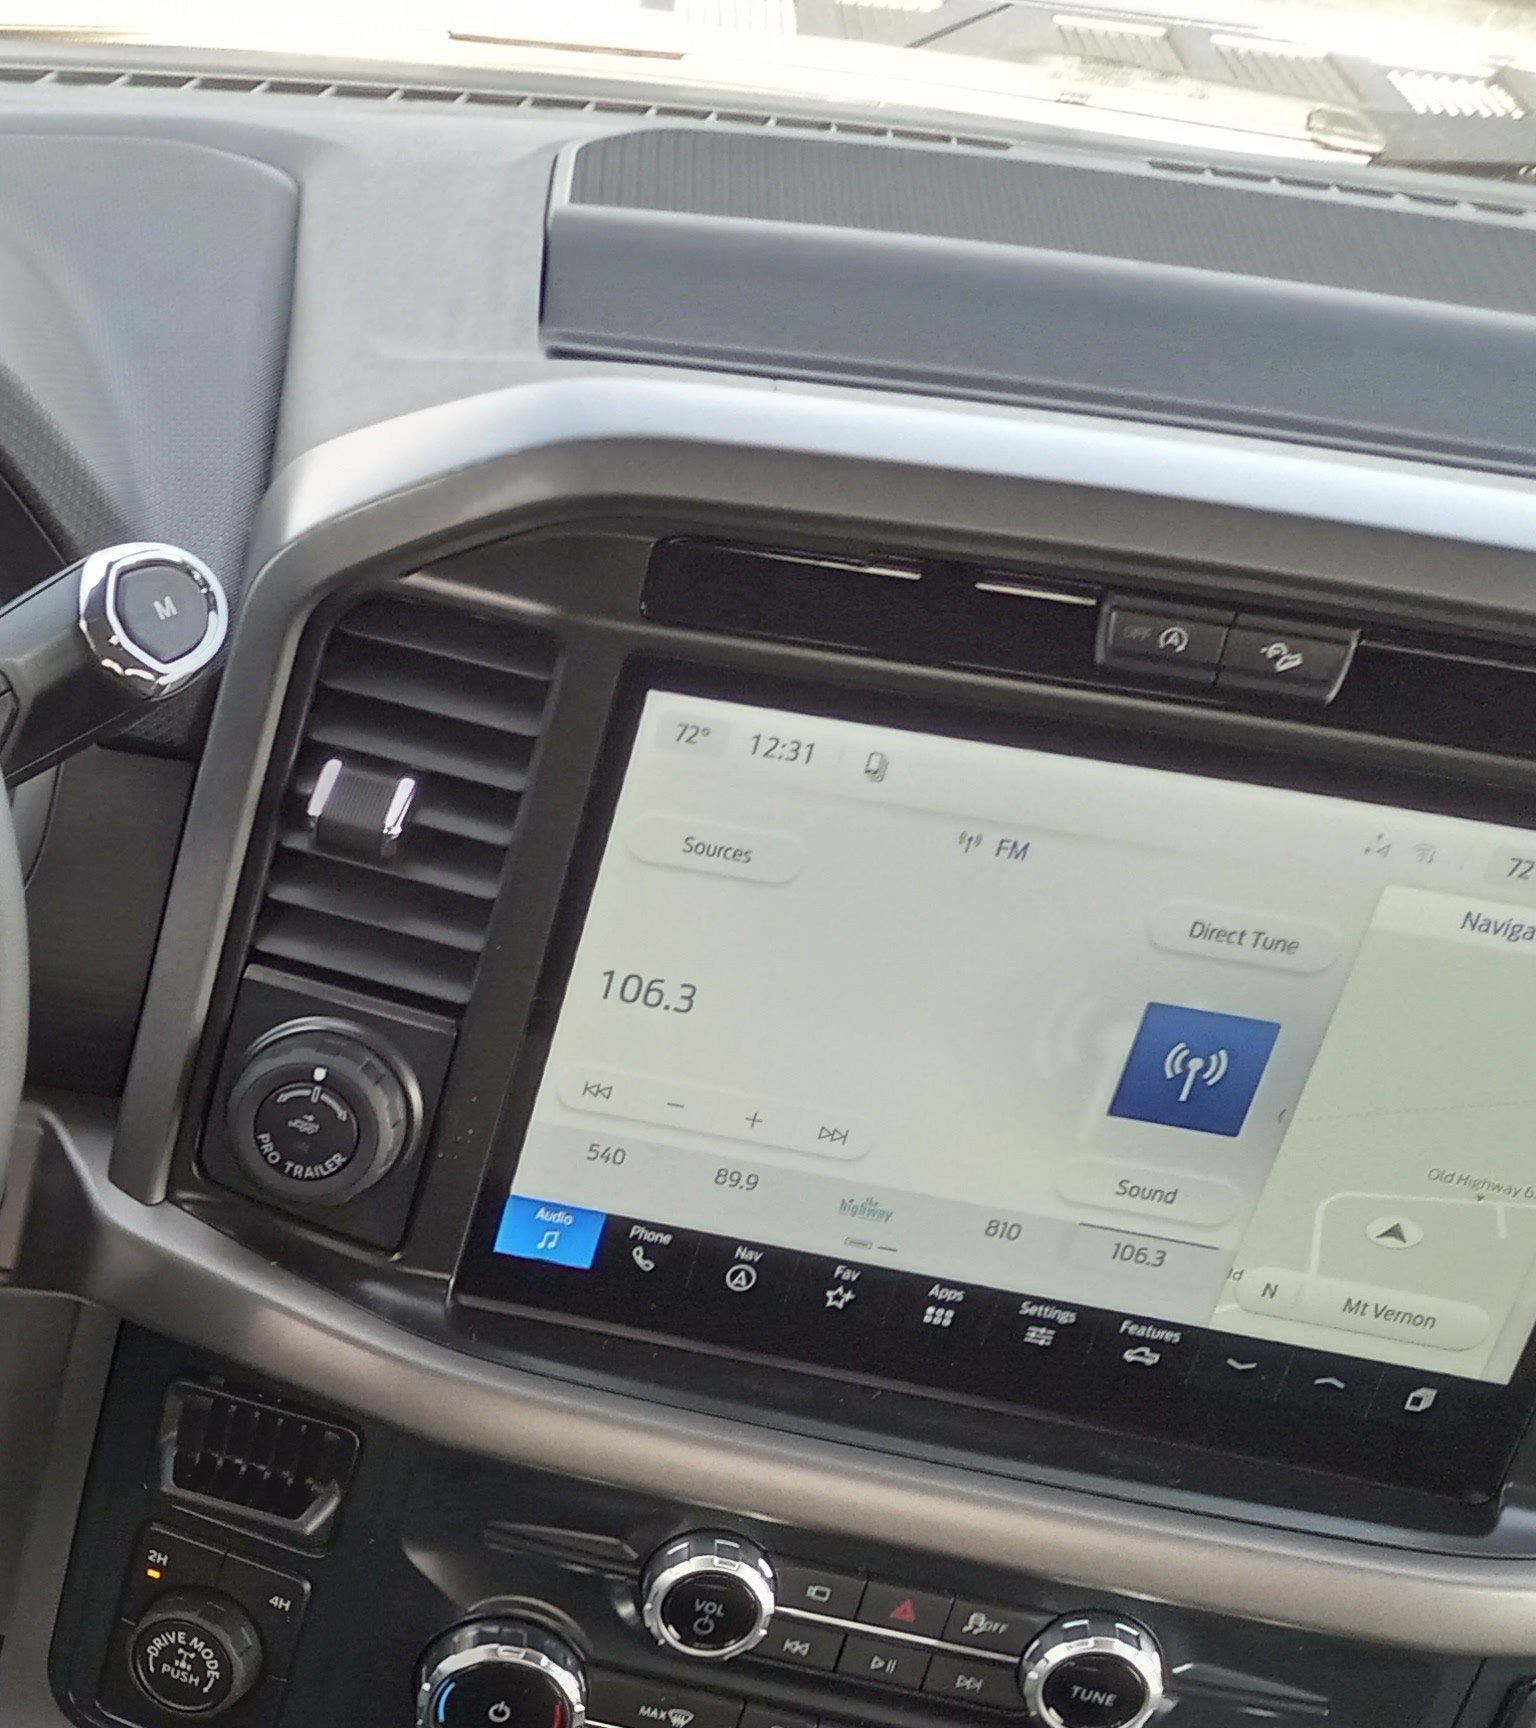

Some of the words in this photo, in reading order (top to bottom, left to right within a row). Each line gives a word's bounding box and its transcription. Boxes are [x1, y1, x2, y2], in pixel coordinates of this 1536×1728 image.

[153, 596, 177, 620] M
[748, 734, 816, 765] 12:31
[681, 836, 753, 865] Sources
[995, 838, 1030, 861] FM
[1188, 920, 1247, 947] Direct
[1251, 930, 1301, 955] Tune
[601, 969, 698, 1014] 106.3
[257, 1132, 281, 1164] PRO
[284, 1152, 348, 1179] TRAILER
[586, 1143, 626, 1166] 540
[713, 1167, 759, 1191] 89.9
[1427, 1168, 1455, 1185] Old
[1456, 1175, 1521, 1199] Highway
[1115, 1179, 1178, 1205] Sound
[535, 1206, 573, 1226] Audio
[629, 1225, 673, 1245] Phone
[984, 1218, 1022, 1241] 810
[734, 1245, 763, 1263] Nav
[1111, 1241, 1167, 1268] 106.3
[833, 1265, 861, 1283] Fav
[927, 1284, 965, 1303] Apps
[1261, 1283, 1278, 1299] N
[1019, 1301, 1077, 1326] Settings
[1342, 1298, 1369, 1318] Mt
[1373, 1304, 1436, 1330] Vernon
[1120, 1320, 1181, 1344] Features
[147, 1549, 168, 1566] 2H
[268, 1595, 291, 1612] 4H
[694, 1598, 725, 1617] VOL
[983, 1620, 1009, 1636] OFF
[146, 1631, 186, 1658] DRIVE
[189, 1637, 220, 1680] MODE
[161, 1662, 200, 1687] PUSH
[1069, 1684, 1117, 1707] TUNE
[639, 1705, 666, 1722] MAX
